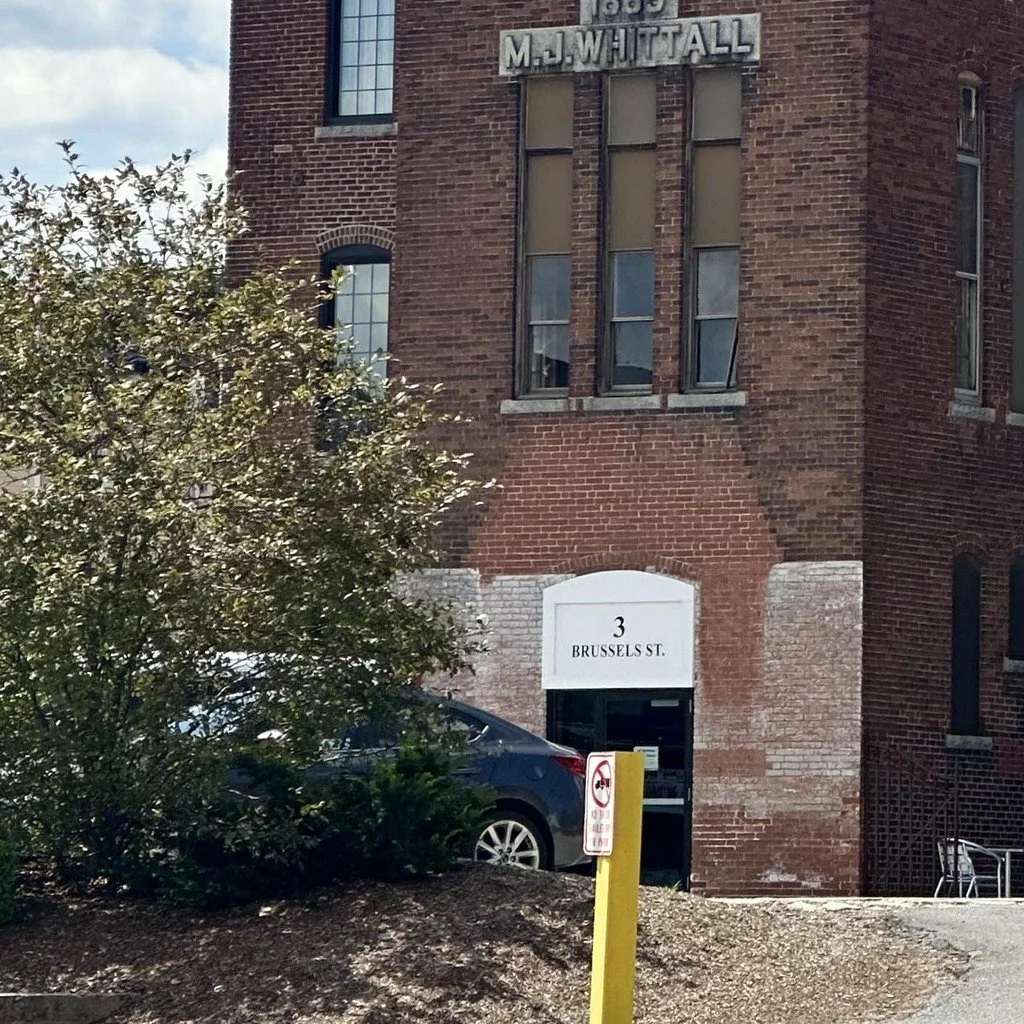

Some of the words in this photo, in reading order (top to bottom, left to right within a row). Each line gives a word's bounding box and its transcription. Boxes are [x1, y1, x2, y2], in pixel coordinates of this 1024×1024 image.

[612, 616, 626, 638] 3
[571, 643, 641, 659] BRUSSELS
[645, 643, 665, 657] ST.
